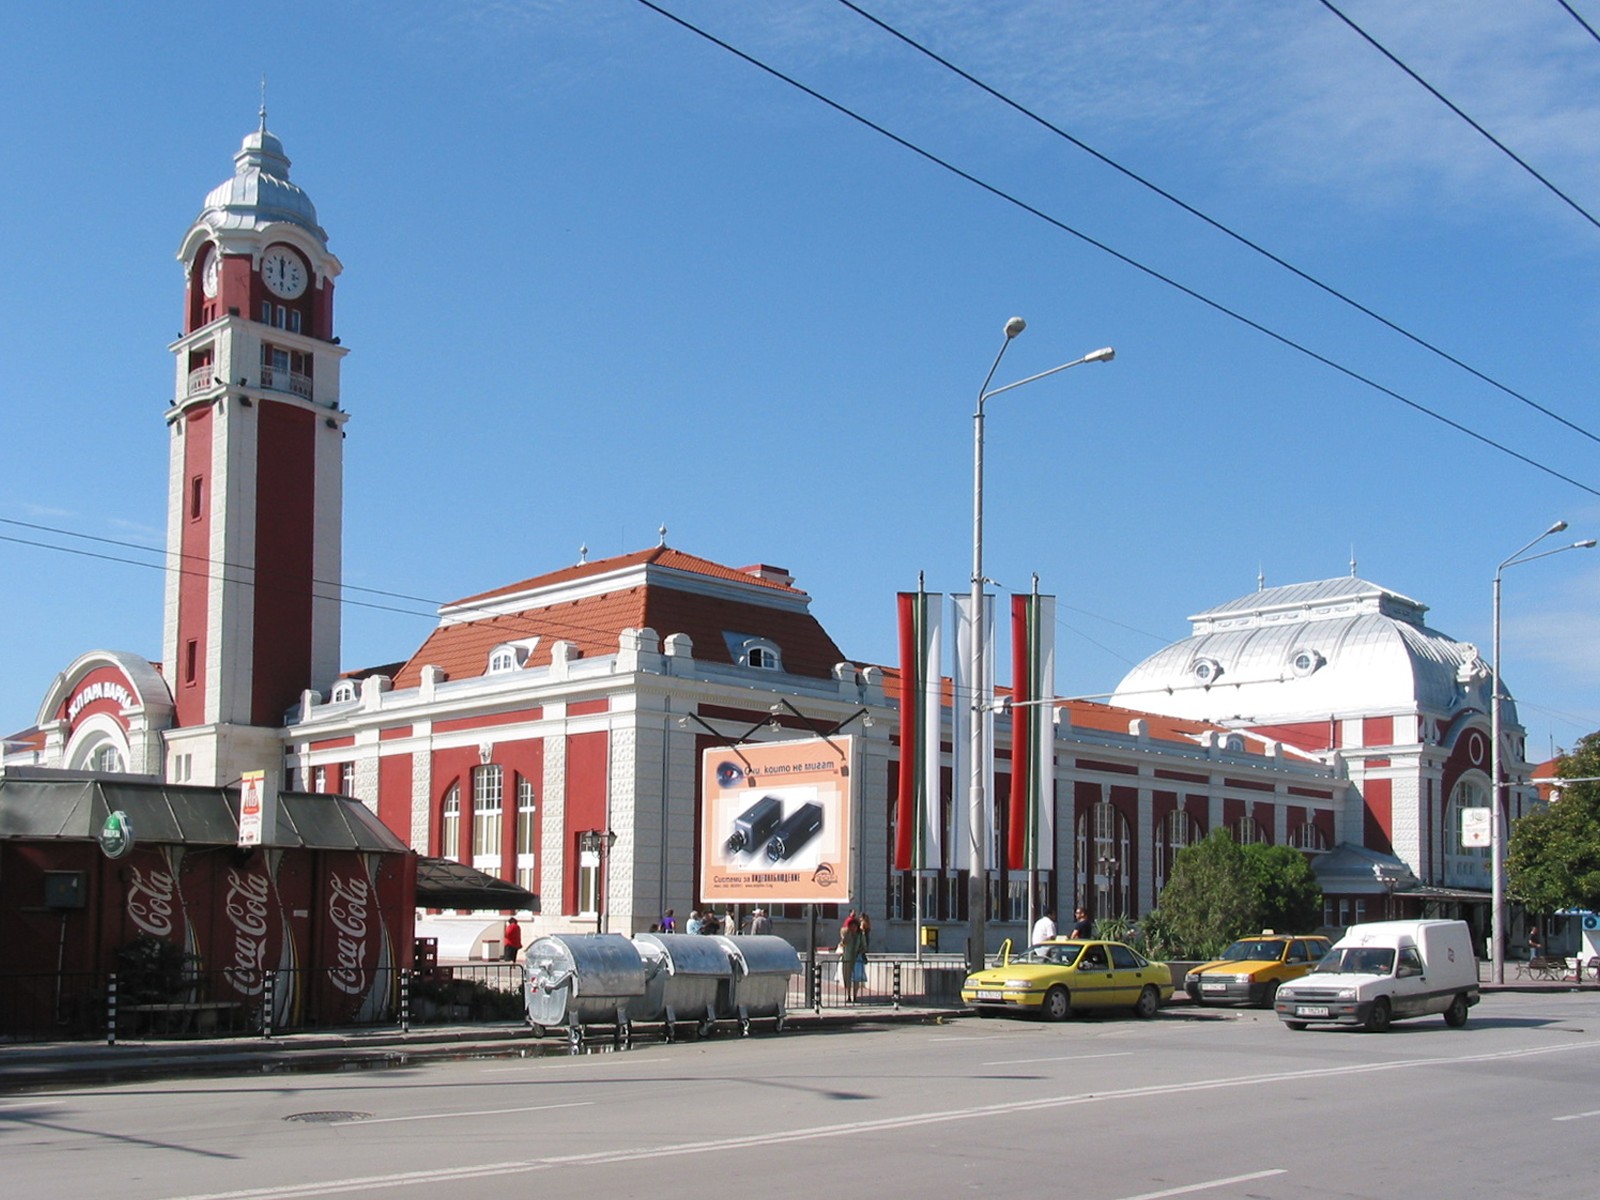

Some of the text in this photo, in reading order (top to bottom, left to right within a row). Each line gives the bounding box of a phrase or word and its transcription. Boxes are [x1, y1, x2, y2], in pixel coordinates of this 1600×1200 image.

[83, 682, 103, 705] ГАРА
[103, 681, 132, 709] ВАРНА
[793, 763, 803, 772] не
[805, 761, 835, 771] мигат
[127, 865, 174, 936] Cola
